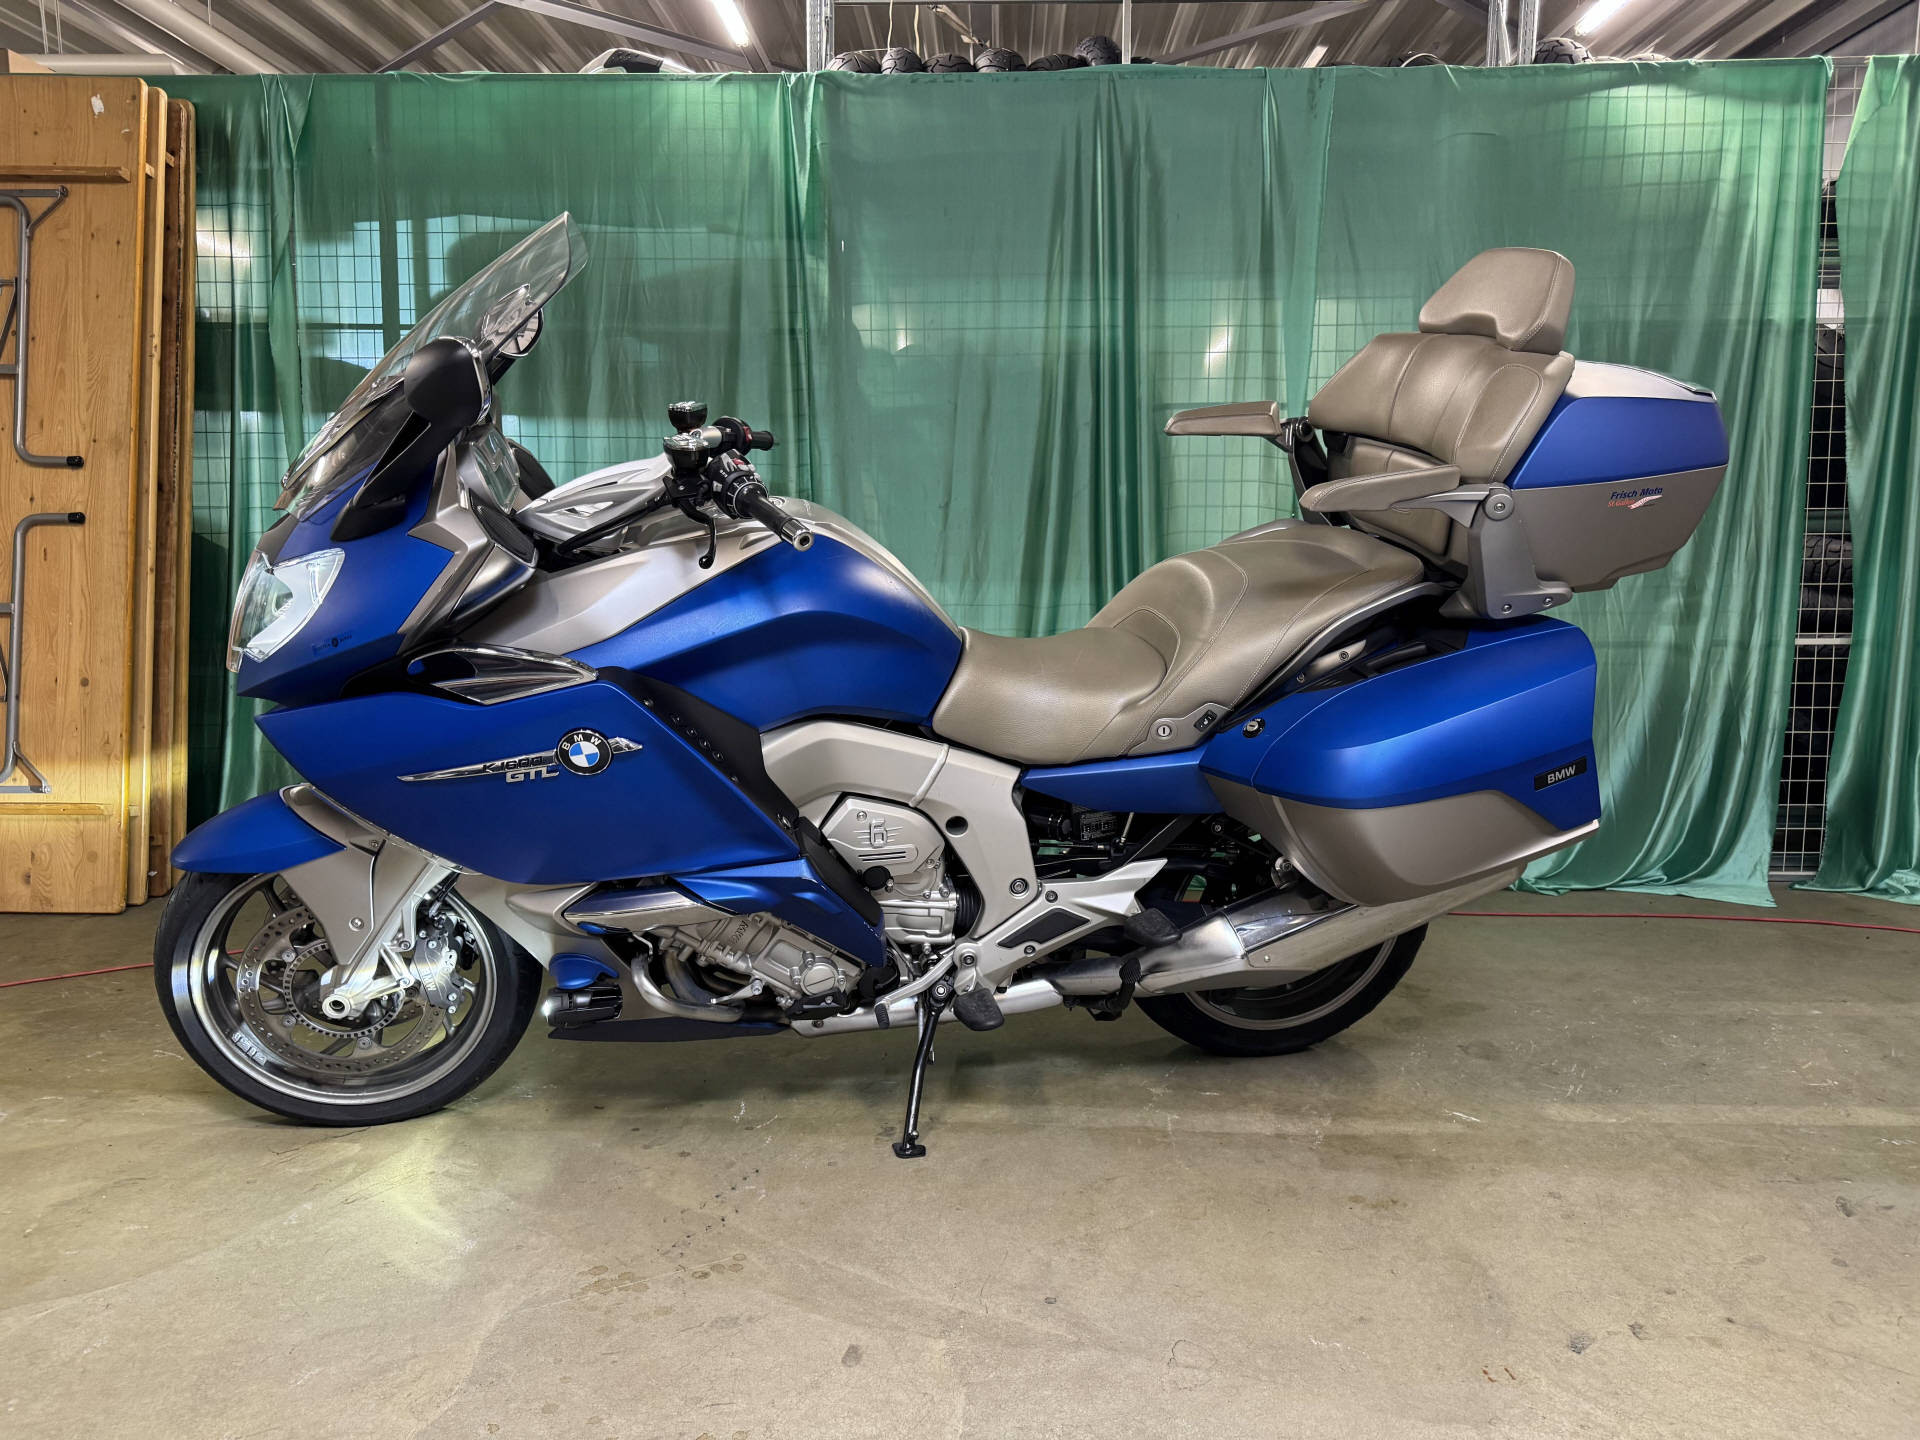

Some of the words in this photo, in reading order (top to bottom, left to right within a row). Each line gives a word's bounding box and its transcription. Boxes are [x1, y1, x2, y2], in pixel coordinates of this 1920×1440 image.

[1611, 490, 1638, 500] Frisch
[1640, 487, 1663, 497] Moto
[561, 734, 601, 751] BMW
[506, 767, 559, 783] GTL
[1547, 764, 1576, 784] BMW
